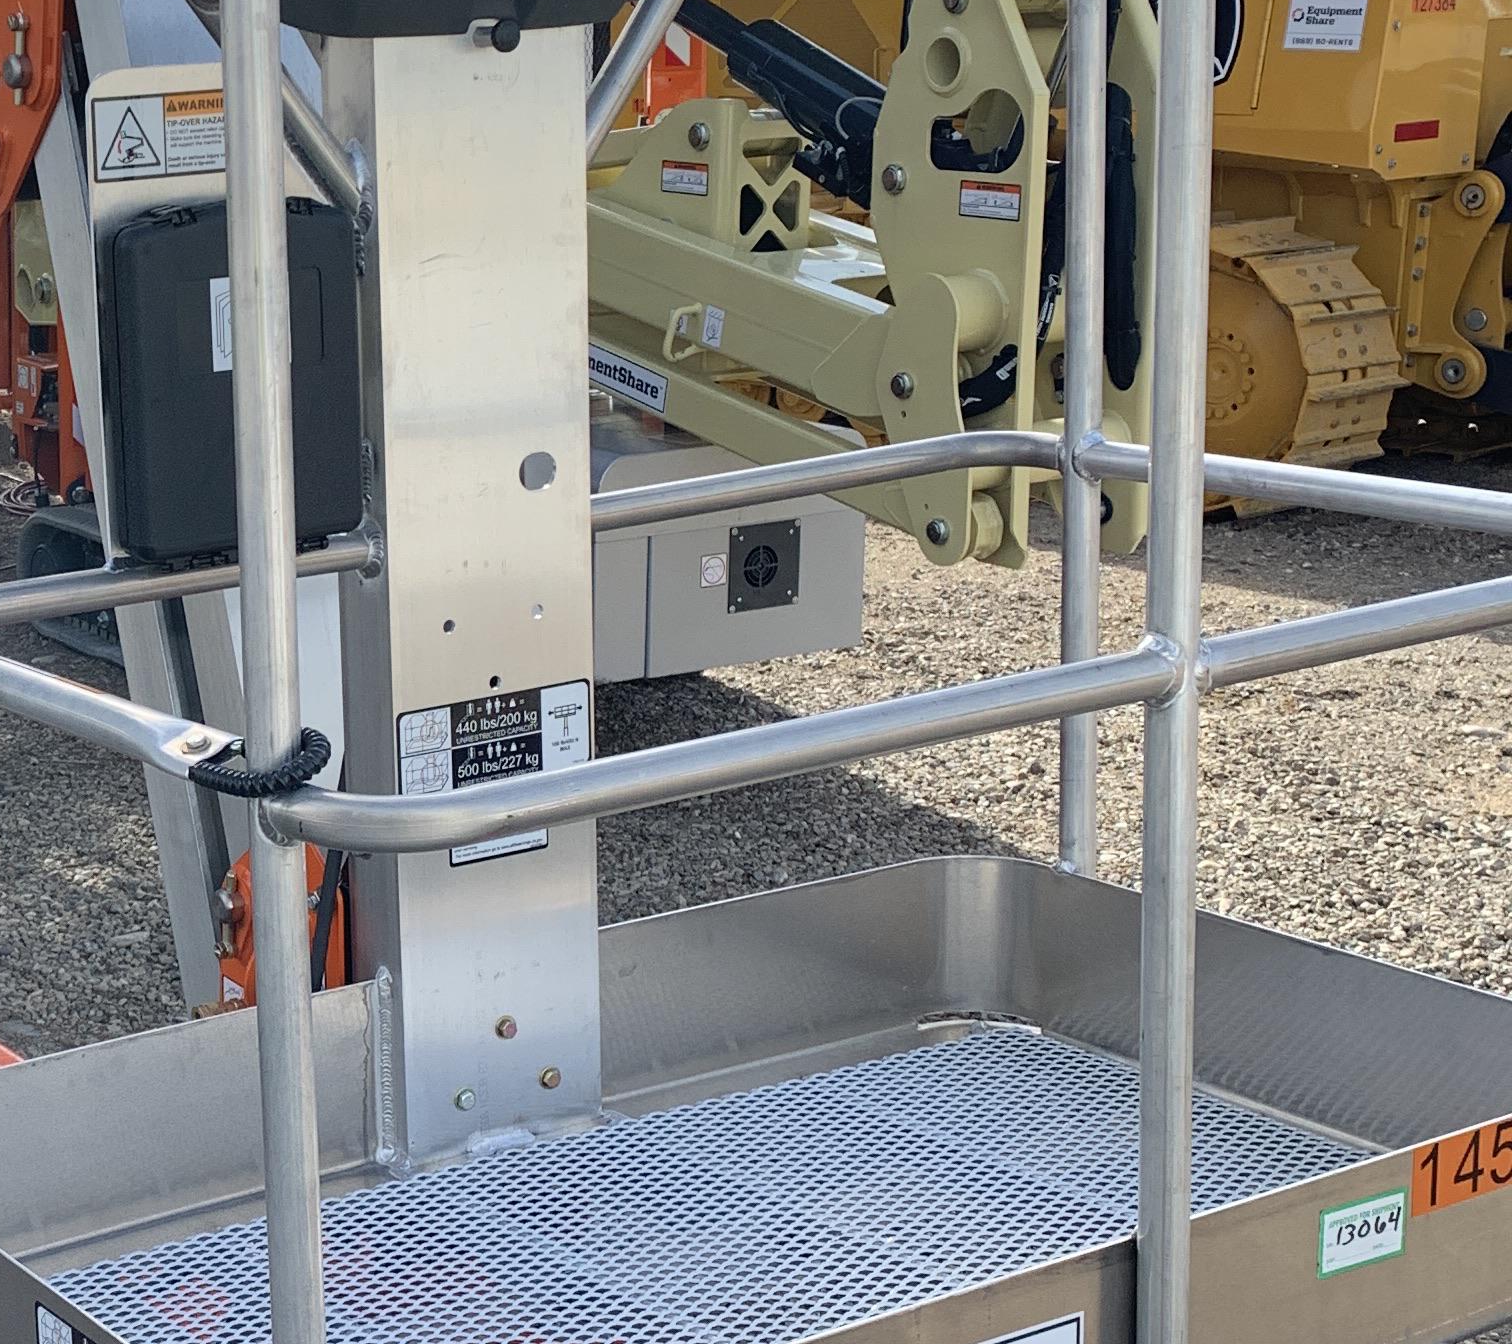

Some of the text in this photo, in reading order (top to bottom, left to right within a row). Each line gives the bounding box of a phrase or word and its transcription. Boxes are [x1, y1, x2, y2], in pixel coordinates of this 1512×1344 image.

[1305, 15, 1336, 25] Share
[1306, 6, 1363, 19] Equipment
[167, 118, 201, 127] TIP-OVER
[455, 709, 538, 735] 440 lbs/200 kg
[456, 723, 538, 745] UNRESTRICTED CAPACITY
[458, 752, 539, 778] 500 lbs/227 kg
[1336, 1206, 1402, 1246] 13064
